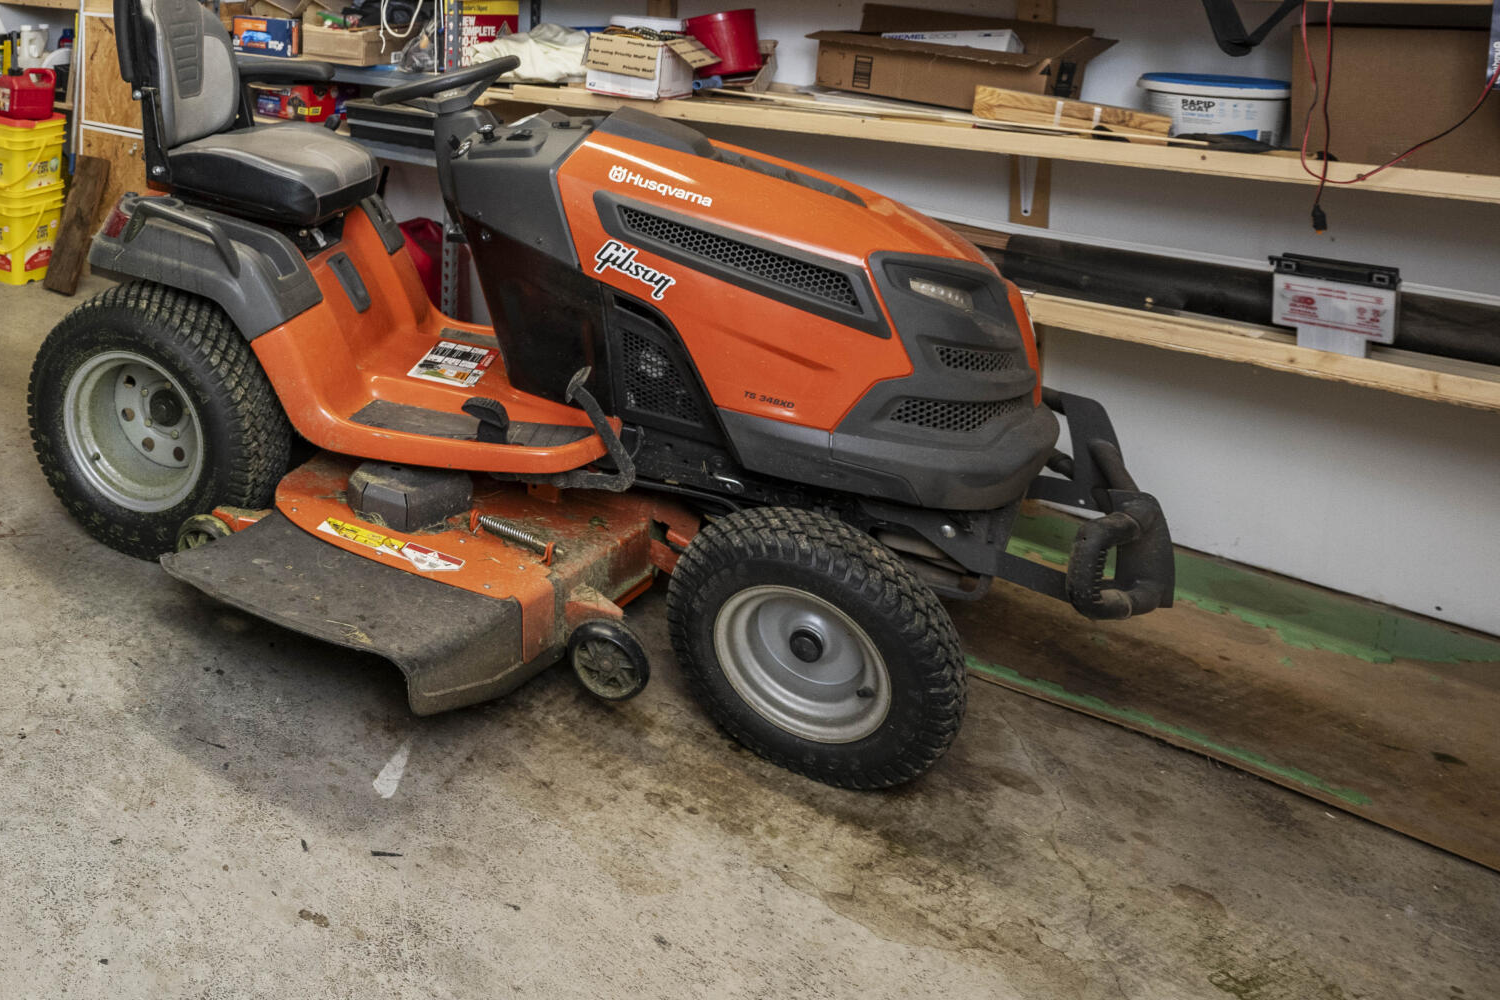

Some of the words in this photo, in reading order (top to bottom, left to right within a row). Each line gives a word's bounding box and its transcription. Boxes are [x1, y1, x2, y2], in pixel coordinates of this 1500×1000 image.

[462, 26, 496, 37] OMPLETE
[614, 50, 632, 59] Priority
[1181, 98, 1216, 109] RAPID
[1181, 104, 1210, 112] COAT
[625, 171, 713, 207] Husqvarna
[595, 240, 676, 300] Gibson
[744, 390, 756, 400] TS
